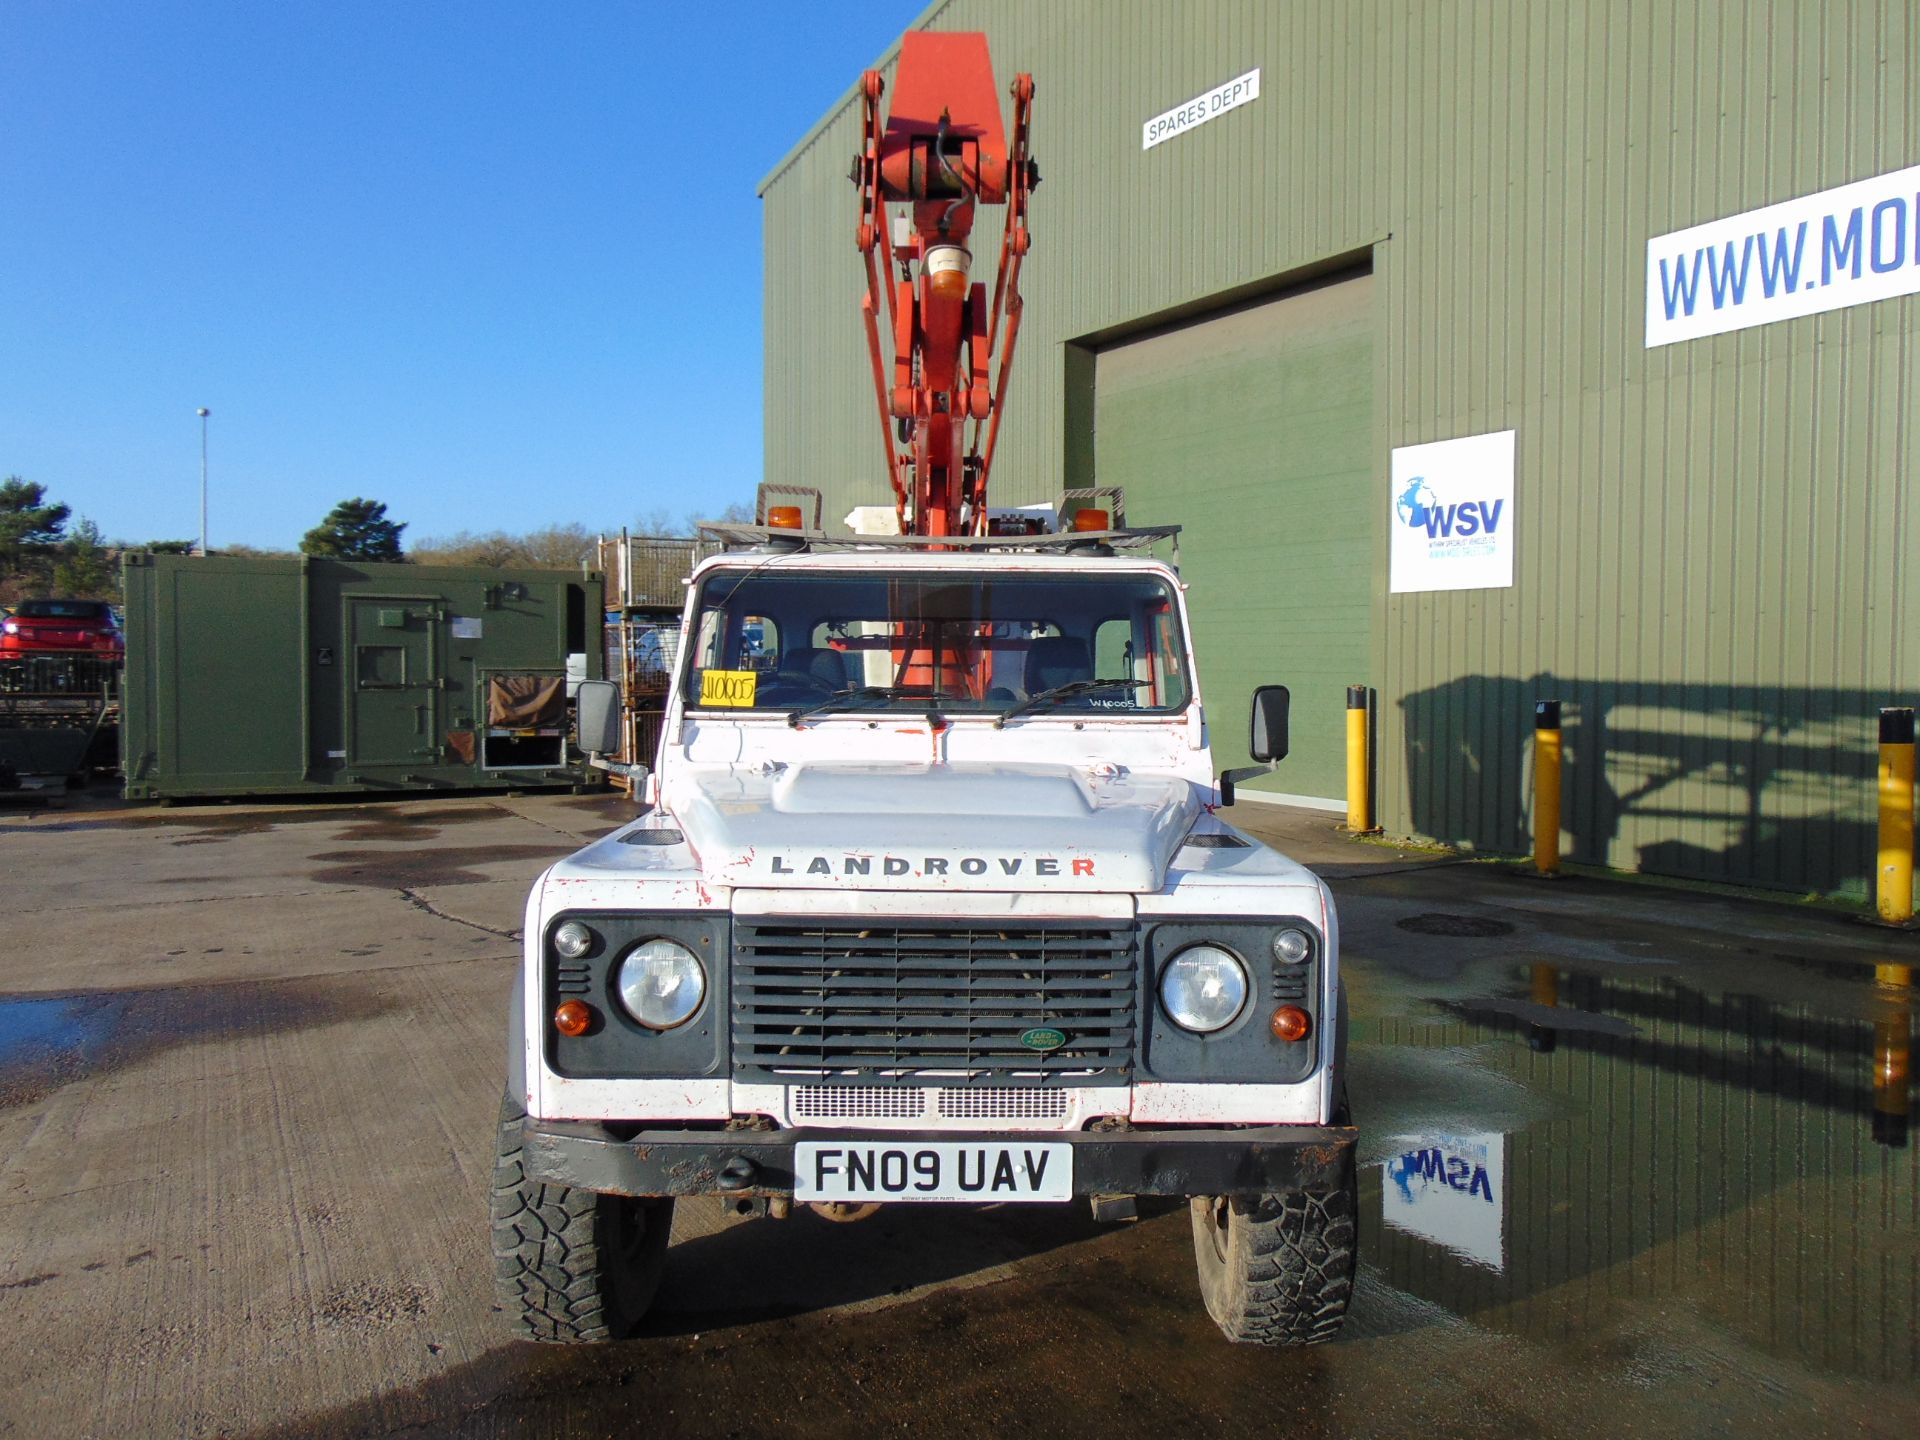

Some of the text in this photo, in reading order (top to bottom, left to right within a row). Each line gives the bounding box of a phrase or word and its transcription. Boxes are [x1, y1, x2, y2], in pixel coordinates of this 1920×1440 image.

[1149, 77, 1253, 141] SPARES DEPT
[1659, 191, 1920, 321] WWW.MO
[1422, 498, 1504, 539] WSV
[1089, 698, 1135, 709] W10005
[815, 1150, 1050, 1191] FN09 UAV
